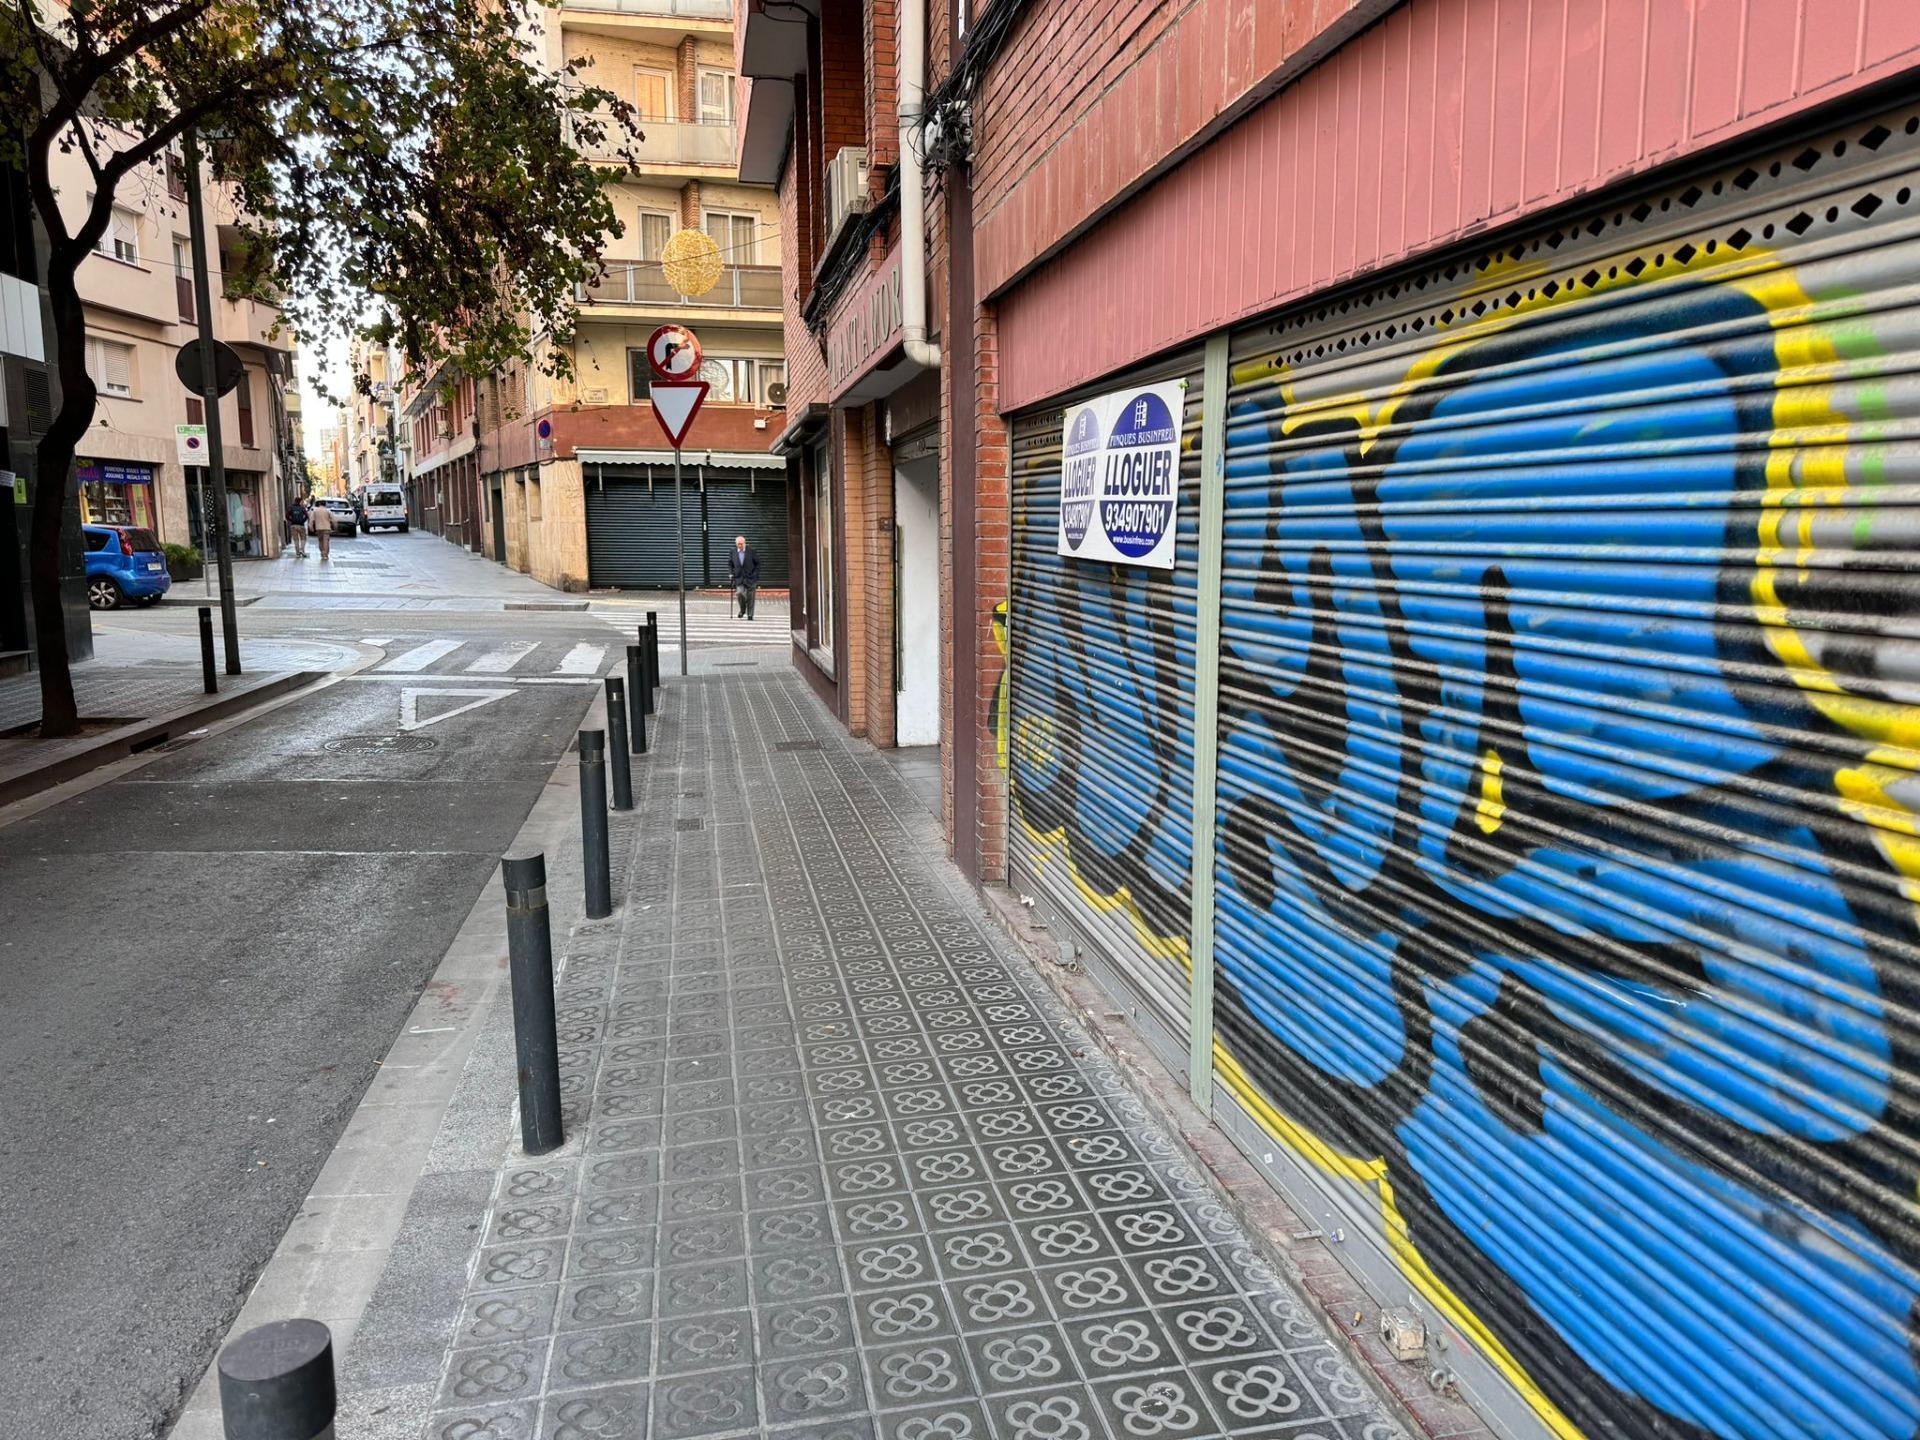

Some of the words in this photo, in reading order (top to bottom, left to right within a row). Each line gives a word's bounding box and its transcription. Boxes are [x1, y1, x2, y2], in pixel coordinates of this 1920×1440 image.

[829, 263, 902, 393] PLANTAMOR
[1064, 457, 1097, 498] LLOGUER
[1104, 450, 1171, 496] LLOGUER
[1105, 503, 1165, 534] 934907901
